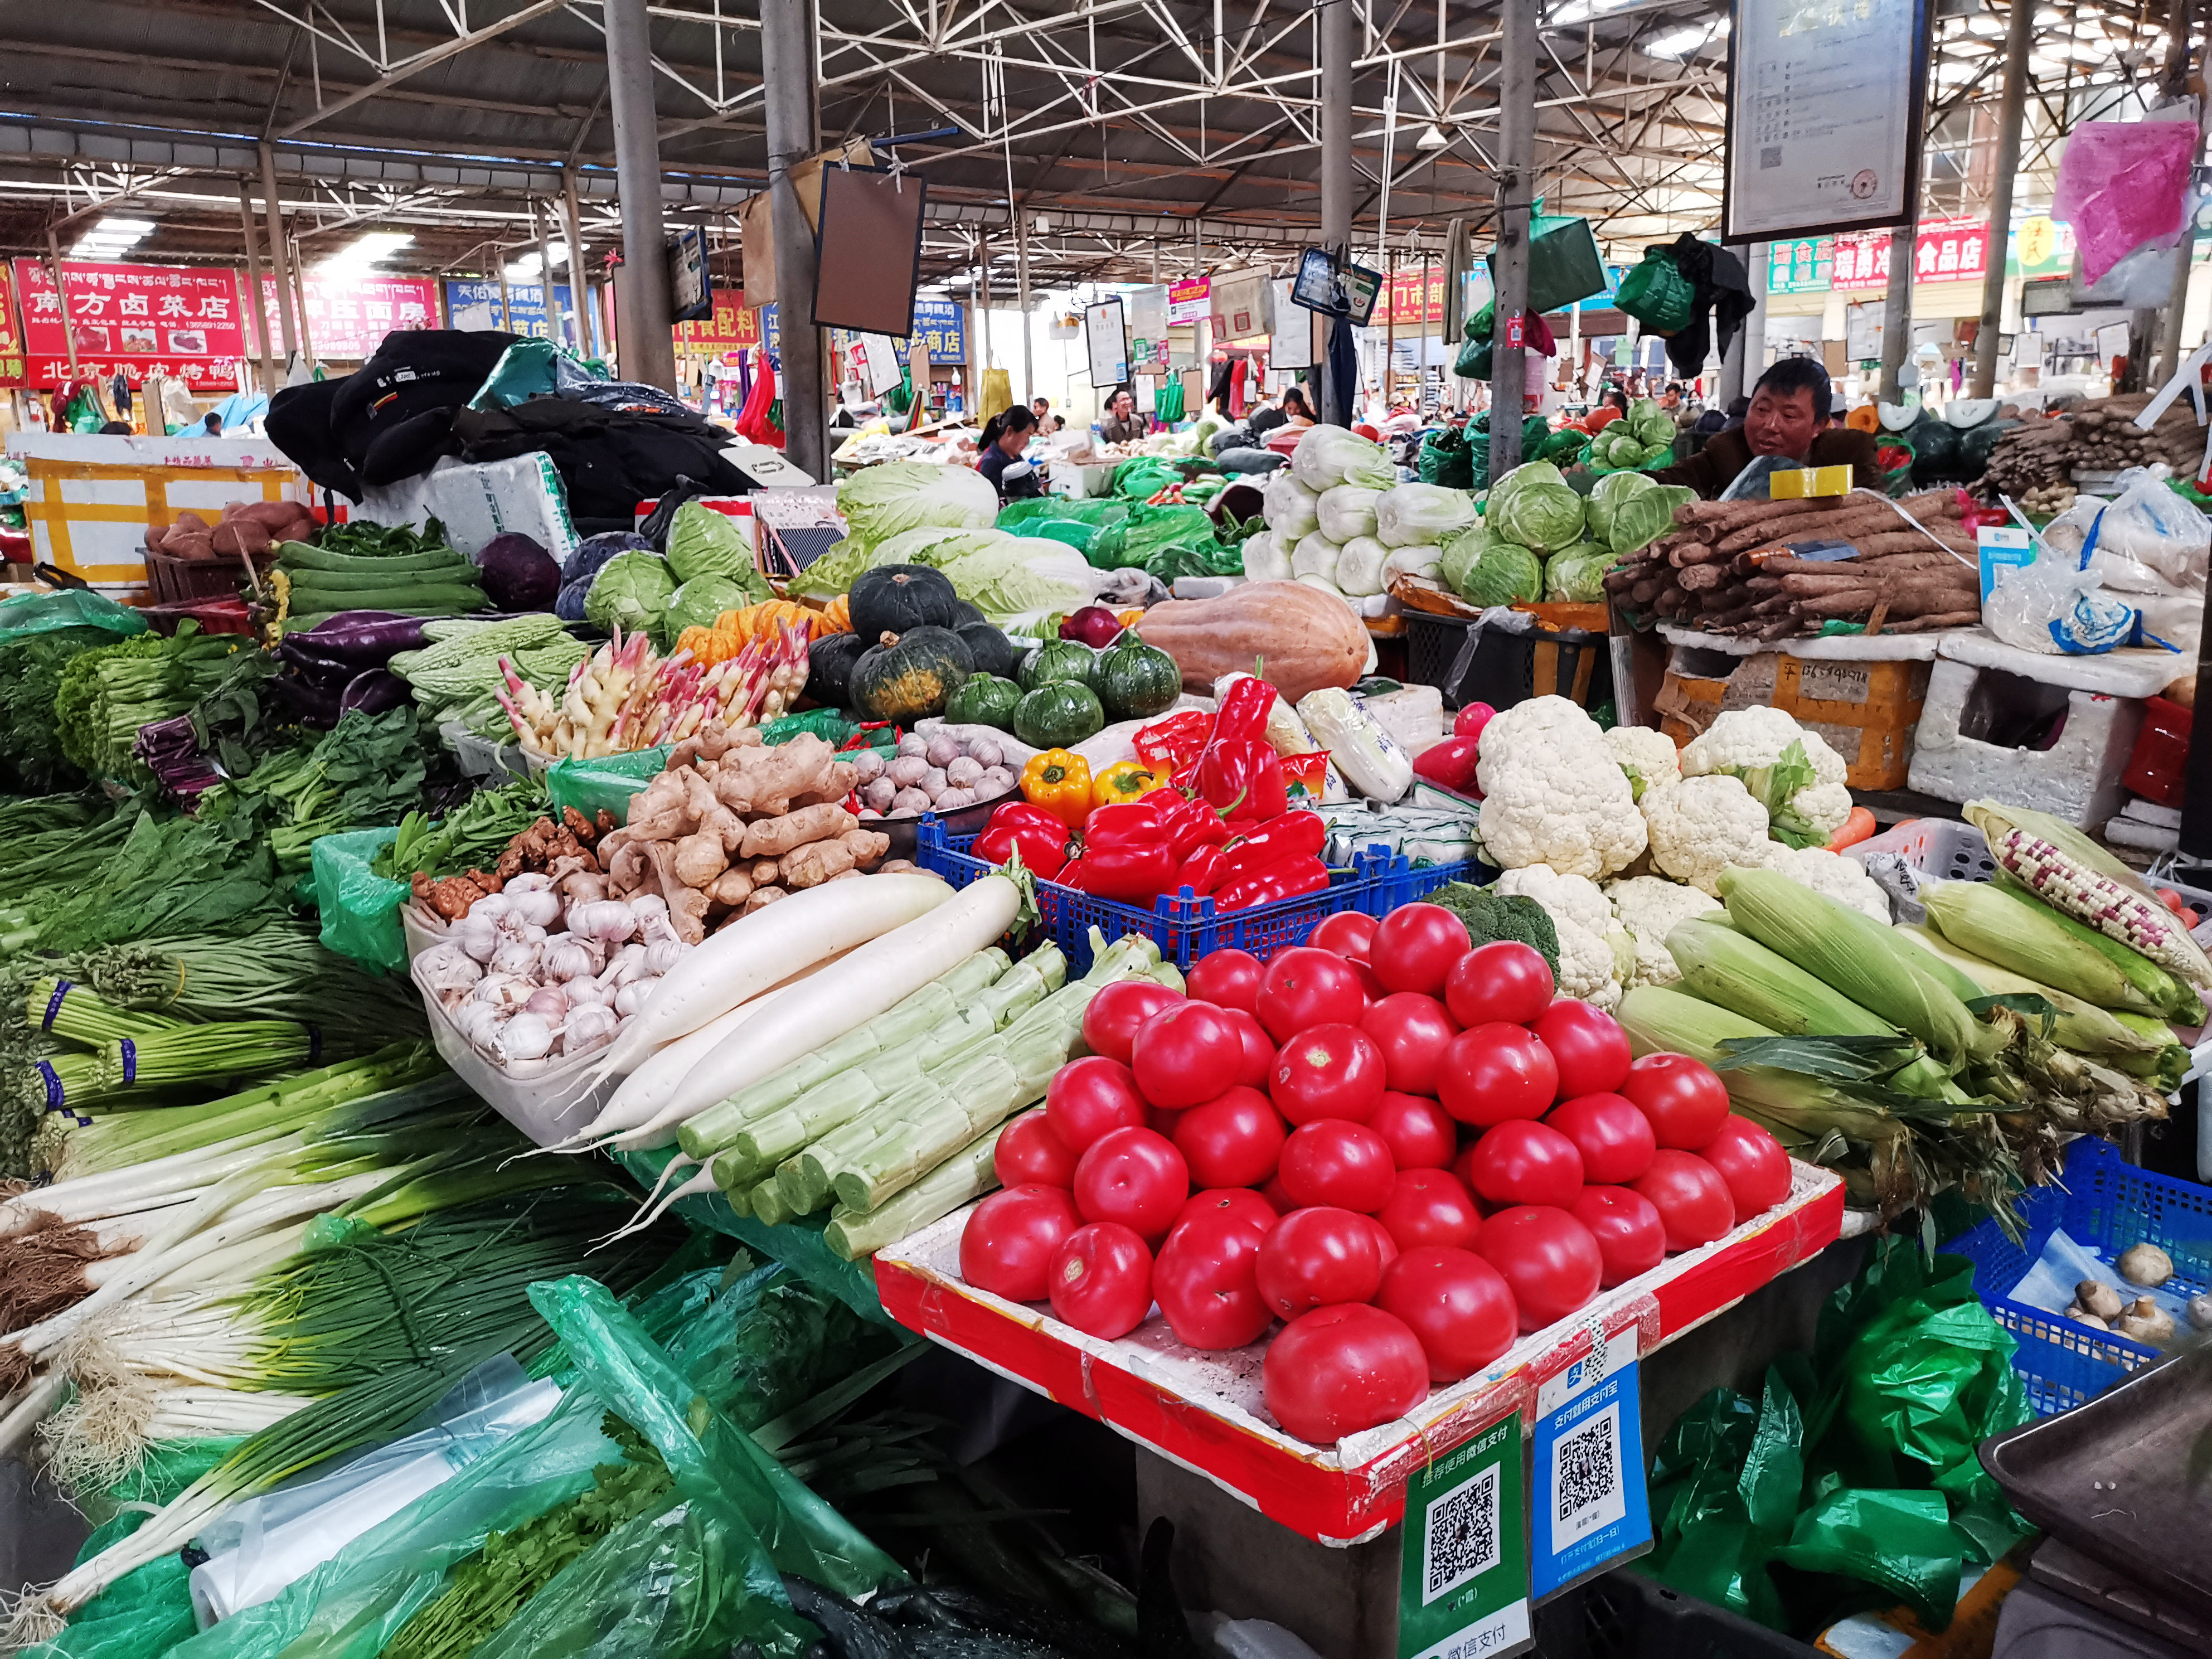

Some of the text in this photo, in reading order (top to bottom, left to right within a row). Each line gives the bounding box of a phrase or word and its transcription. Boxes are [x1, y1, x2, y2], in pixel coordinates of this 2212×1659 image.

[1917, 237, 1983, 274] 食品店
[30, 289, 230, 319] 南方卤菜店
[1554, 1380, 1618, 1430] 支付就用支付宝
[1422, 1424, 1508, 1489] 推荐使用微信支付
[1448, 1623, 1506, 1659] 微信支付
